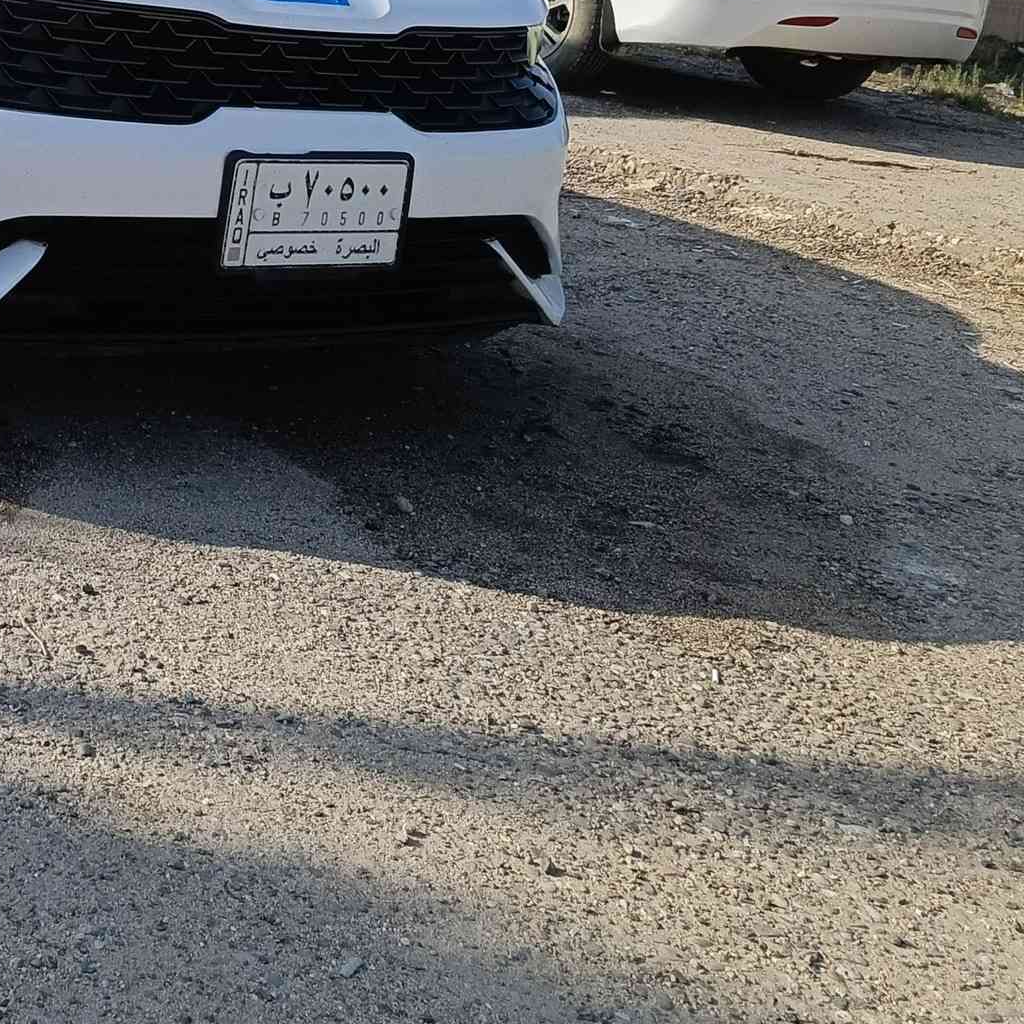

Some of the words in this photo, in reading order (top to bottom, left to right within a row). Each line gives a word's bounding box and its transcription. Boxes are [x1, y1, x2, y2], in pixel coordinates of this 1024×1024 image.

[232, 169, 249, 244] IRAQ
[271, 211, 281, 227] B
[256, 240, 318, 260] خصوصي
[335, 238, 381, 259] البصرة
